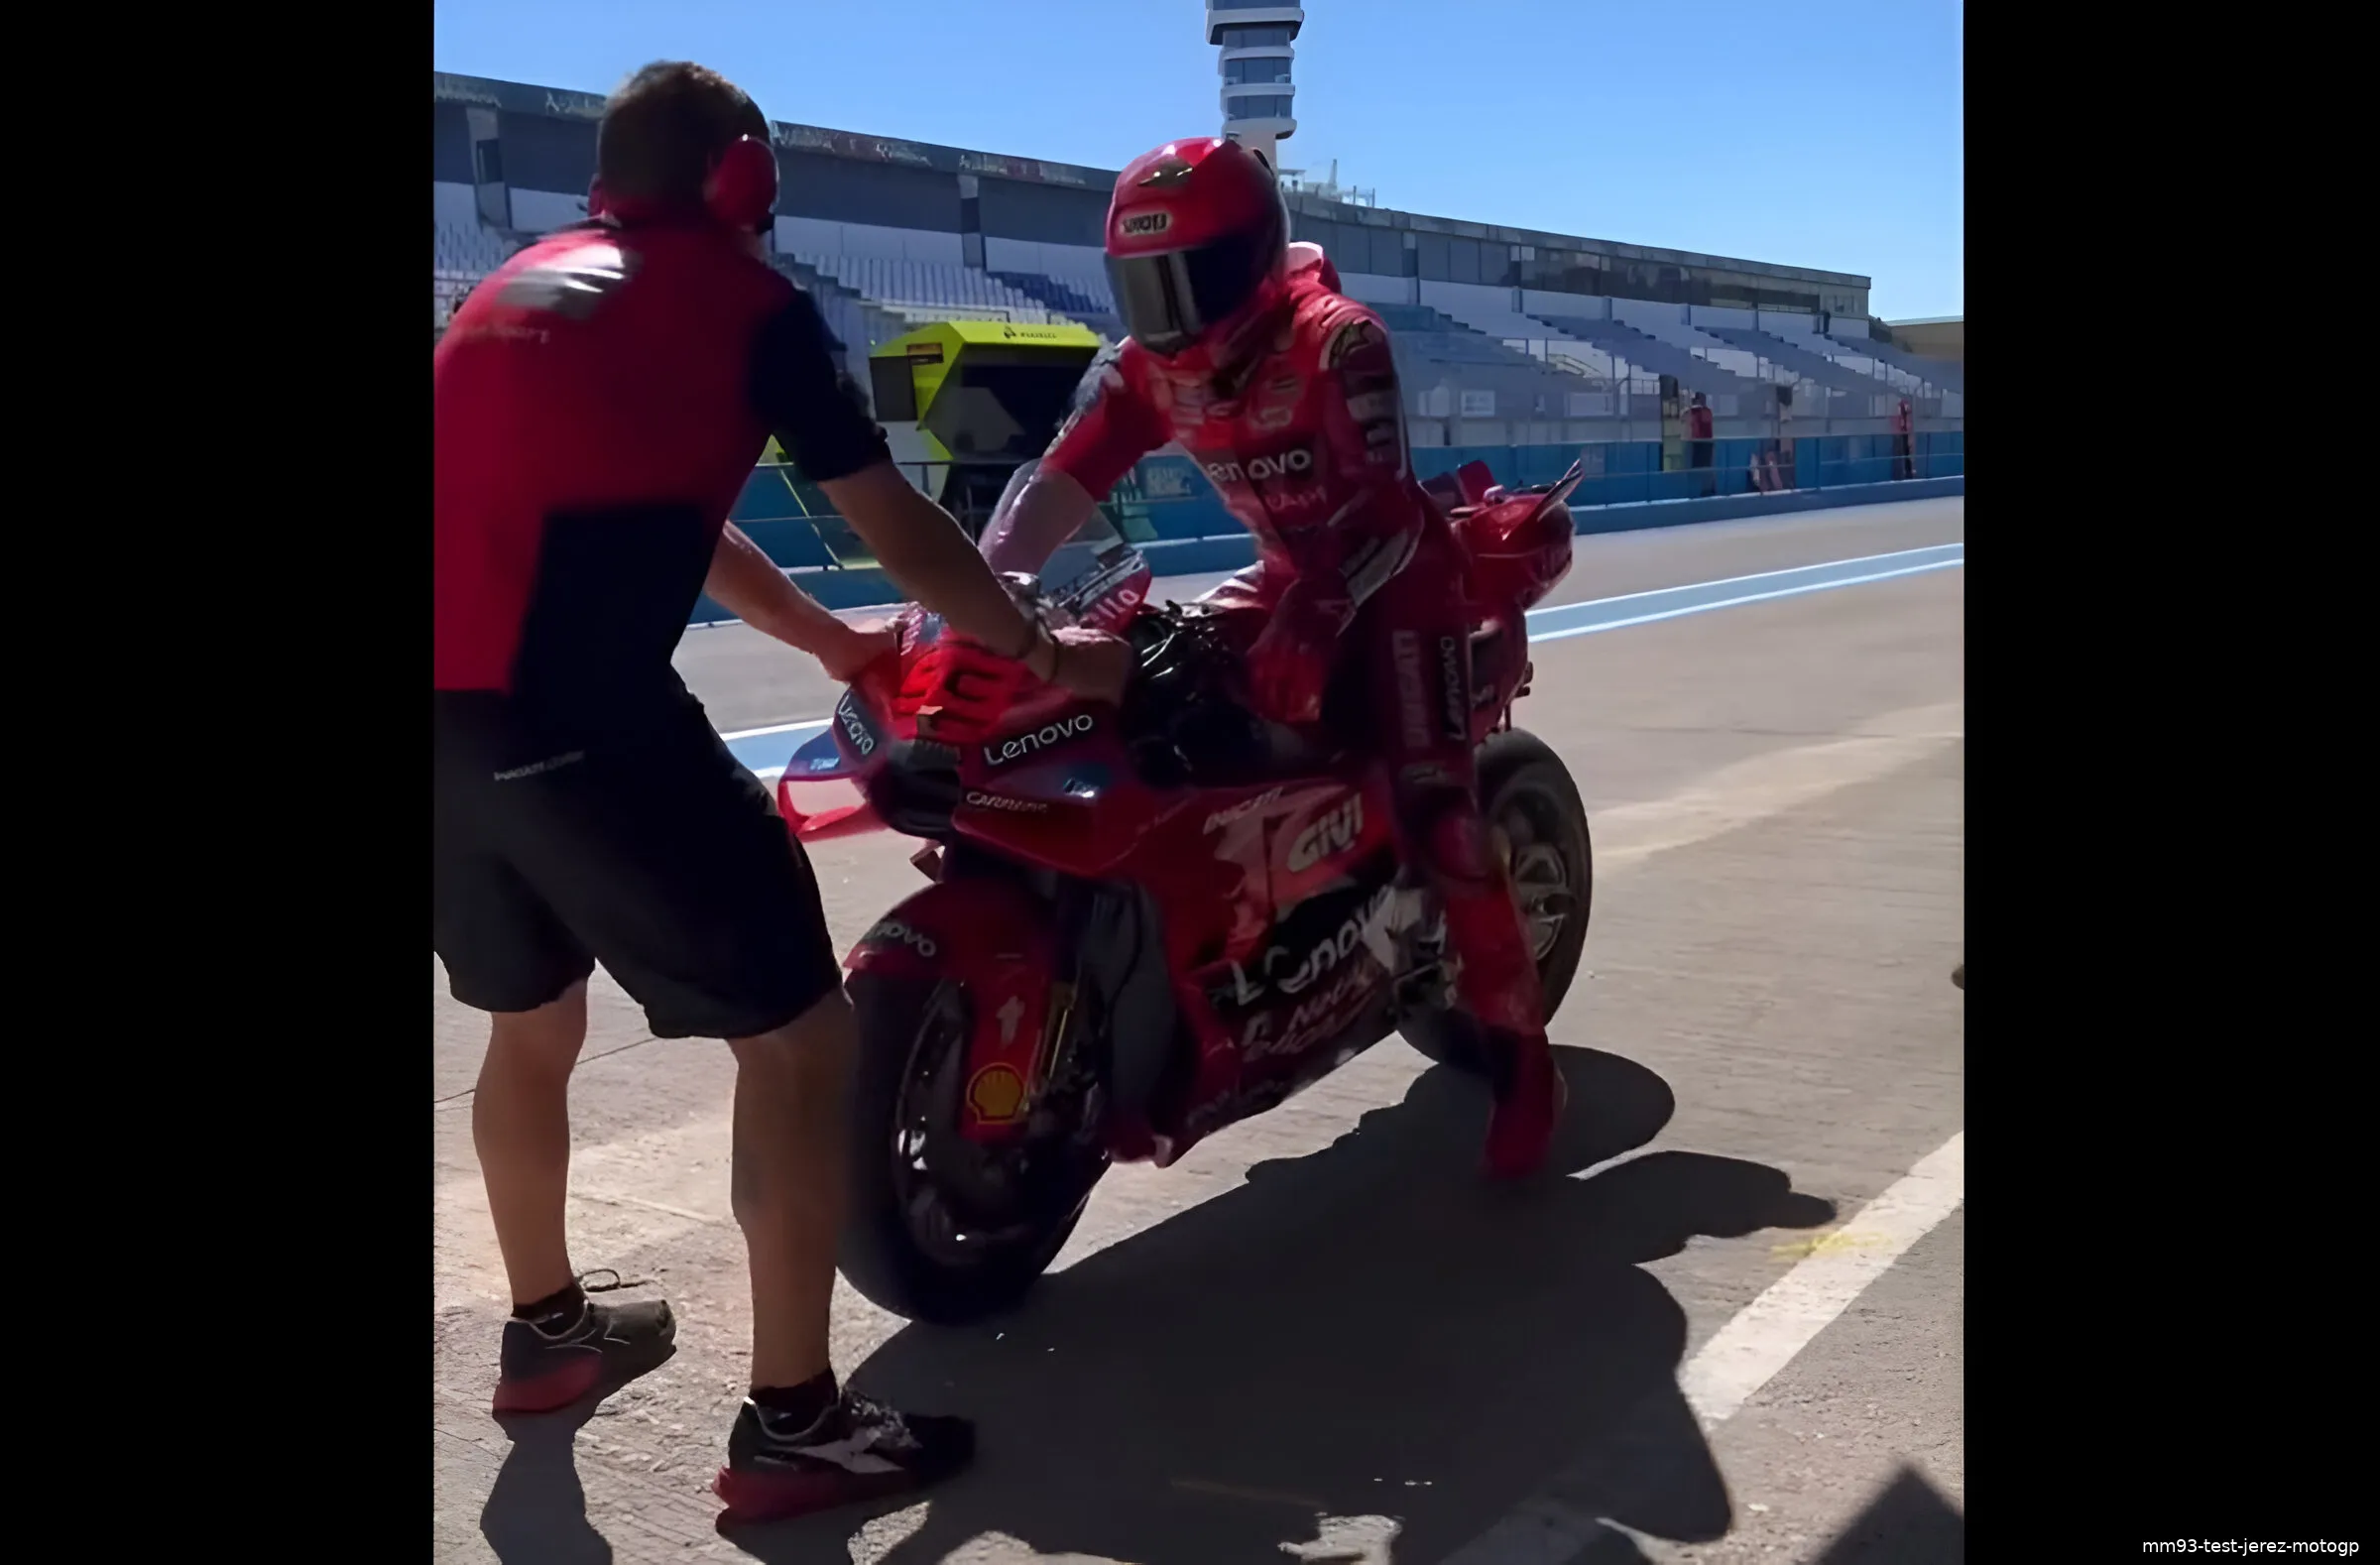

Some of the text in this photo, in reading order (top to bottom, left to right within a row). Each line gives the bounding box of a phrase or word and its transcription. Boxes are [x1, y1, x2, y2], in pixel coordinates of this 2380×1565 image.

[1202, 447, 1312, 482] enovo
[983, 714, 1094, 767] Lenovo
[1286, 792, 1364, 873] GIVI
